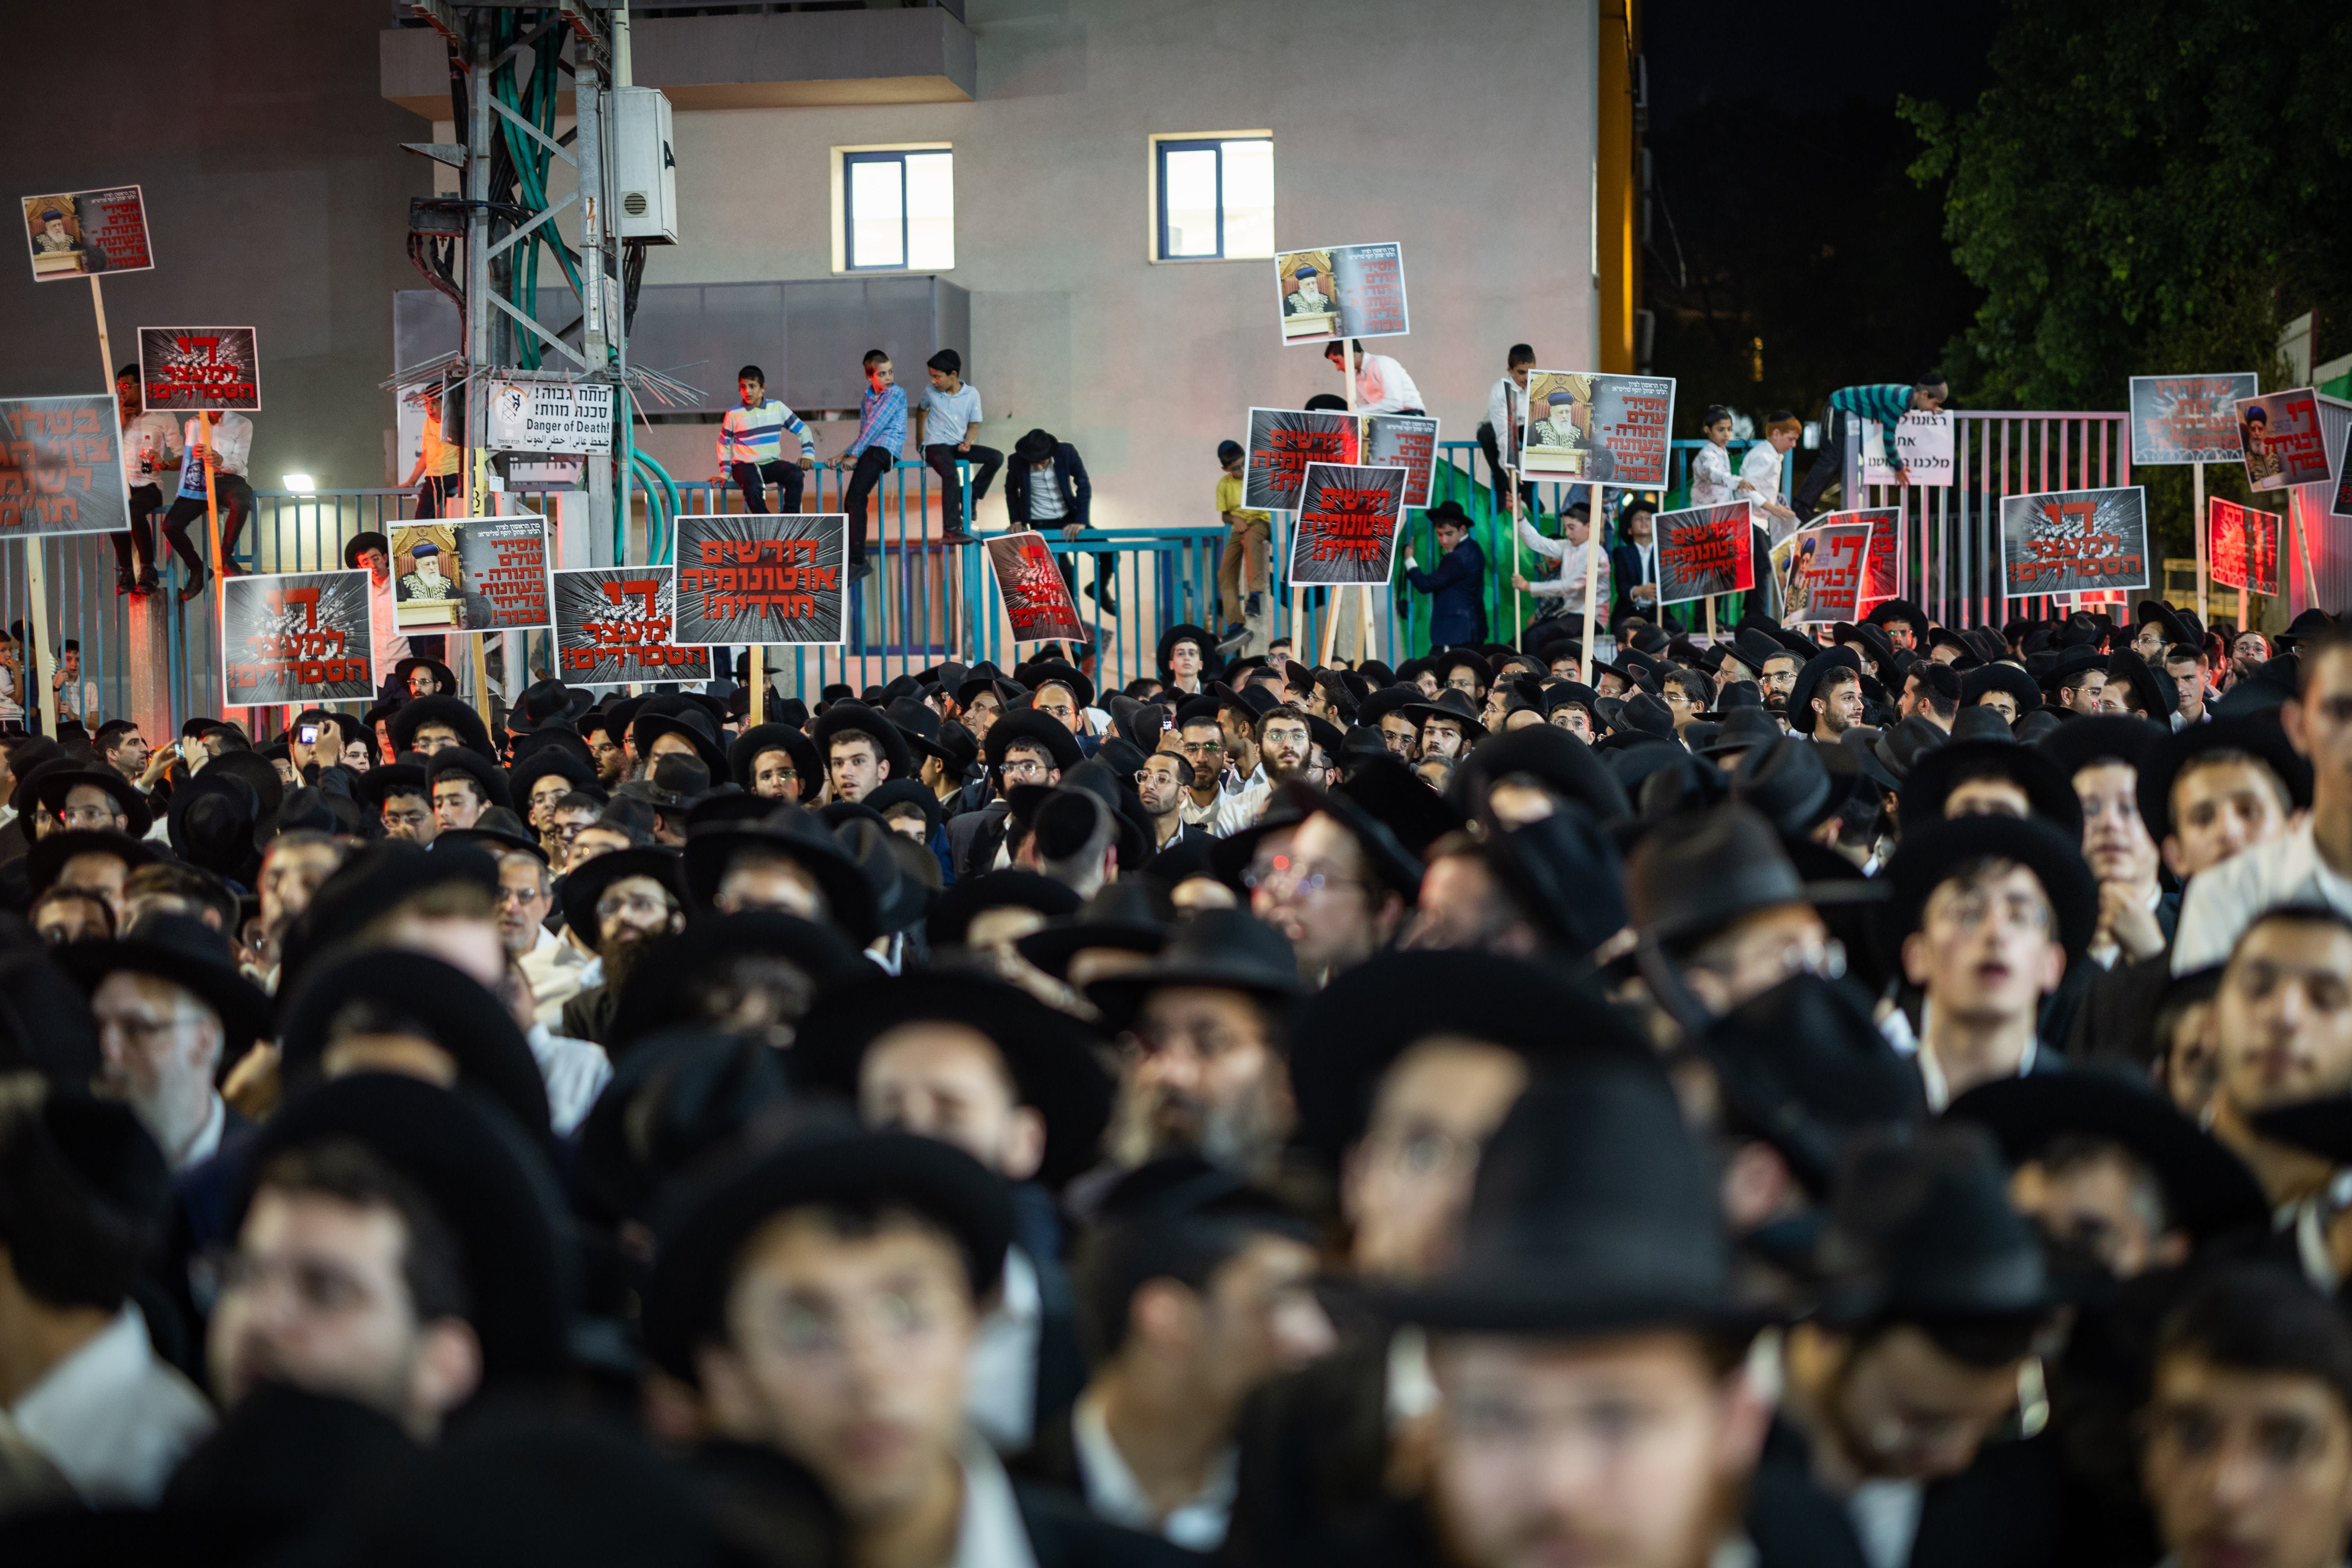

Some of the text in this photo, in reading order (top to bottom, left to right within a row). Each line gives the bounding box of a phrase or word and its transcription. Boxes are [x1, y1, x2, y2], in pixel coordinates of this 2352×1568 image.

[101, 202, 138, 213] אסירי
[108, 212, 140, 224] עולם
[102, 223, 143, 235] התורה
[107, 244, 145, 256] שליחי
[107, 254, 148, 269] צבור!
[1358, 260, 1397, 271] אסירי
[1364, 271, 1397, 283] עולם
[1358, 283, 1399, 295] התורה
[1362, 305, 1401, 318] שליחי
[1362, 318, 1403, 332] צבור!
[177, 337, 219, 363] די
[162, 362, 237, 381] למעצר
[147, 382, 254, 399] הספרדים!
[579, 389, 607, 402] מתח
[2156, 379, 2231, 397] שחררו
[535, 404, 607, 418] סכנת מוות!
[1622, 396, 1667, 411] אסירי
[2177, 398, 2212, 415] את
[8, 405, 101, 436] בטלו
[1627, 408, 1666, 424] עולם
[2286, 399, 2316, 430] די
[527, 418, 610, 433] Danger of Death!
[1616, 424, 1665, 438] התורה
[550, 436, 565, 448] خطر
[590, 436, 609, 446] ضغط
[1270, 429, 1348, 450] דורשים
[1396, 433, 1433, 445] אסירי
[1605, 437, 1664, 452] בעוונות
[1897, 436, 1916, 446] את
[2264, 429, 2320, 455] לבגידה
[1399, 443, 1432, 456] עולם
[1617, 450, 1663, 465] שליחי
[1390, 455, 1430, 468] התורה
[1914, 455, 1950, 468] מלכנו
[2287, 450, 2326, 475] במרן
[1614, 464, 1662, 481] צבור!
[1321, 488, 1390, 510] דורשים
[1302, 512, 1396, 536] אוטונומיה
[2045, 501, 2096, 534] די
[1671, 519, 1737, 545] דורשים
[491, 537, 543, 552] אסירי
[701, 540, 818, 564] דורשים
[1312, 536, 1379, 561] חרדית!
[1661, 536, 1749, 566] אוטונומיה
[1831, 535, 1865, 566] די
[2026, 531, 2120, 558] למעצר
[498, 550, 542, 566] עולם
[1019, 545, 1051, 580] די
[489, 566, 544, 581] התורה
[2010, 555, 2141, 582] הספרדים!
[480, 580, 545, 595] בעוונות
[682, 567, 837, 592] אוטונומיה
[493, 592, 545, 608] שליחי
[603, 580, 658, 617] די
[703, 593, 814, 619] חרדית!
[1812, 589, 1855, 612] במרן
[266, 588, 320, 629] די
[492, 608, 547, 625] צבור!
[247, 626, 345, 658] למעצר
[563, 645, 706, 670] הספרדים!
[230, 658, 368, 688] הספרדים!
